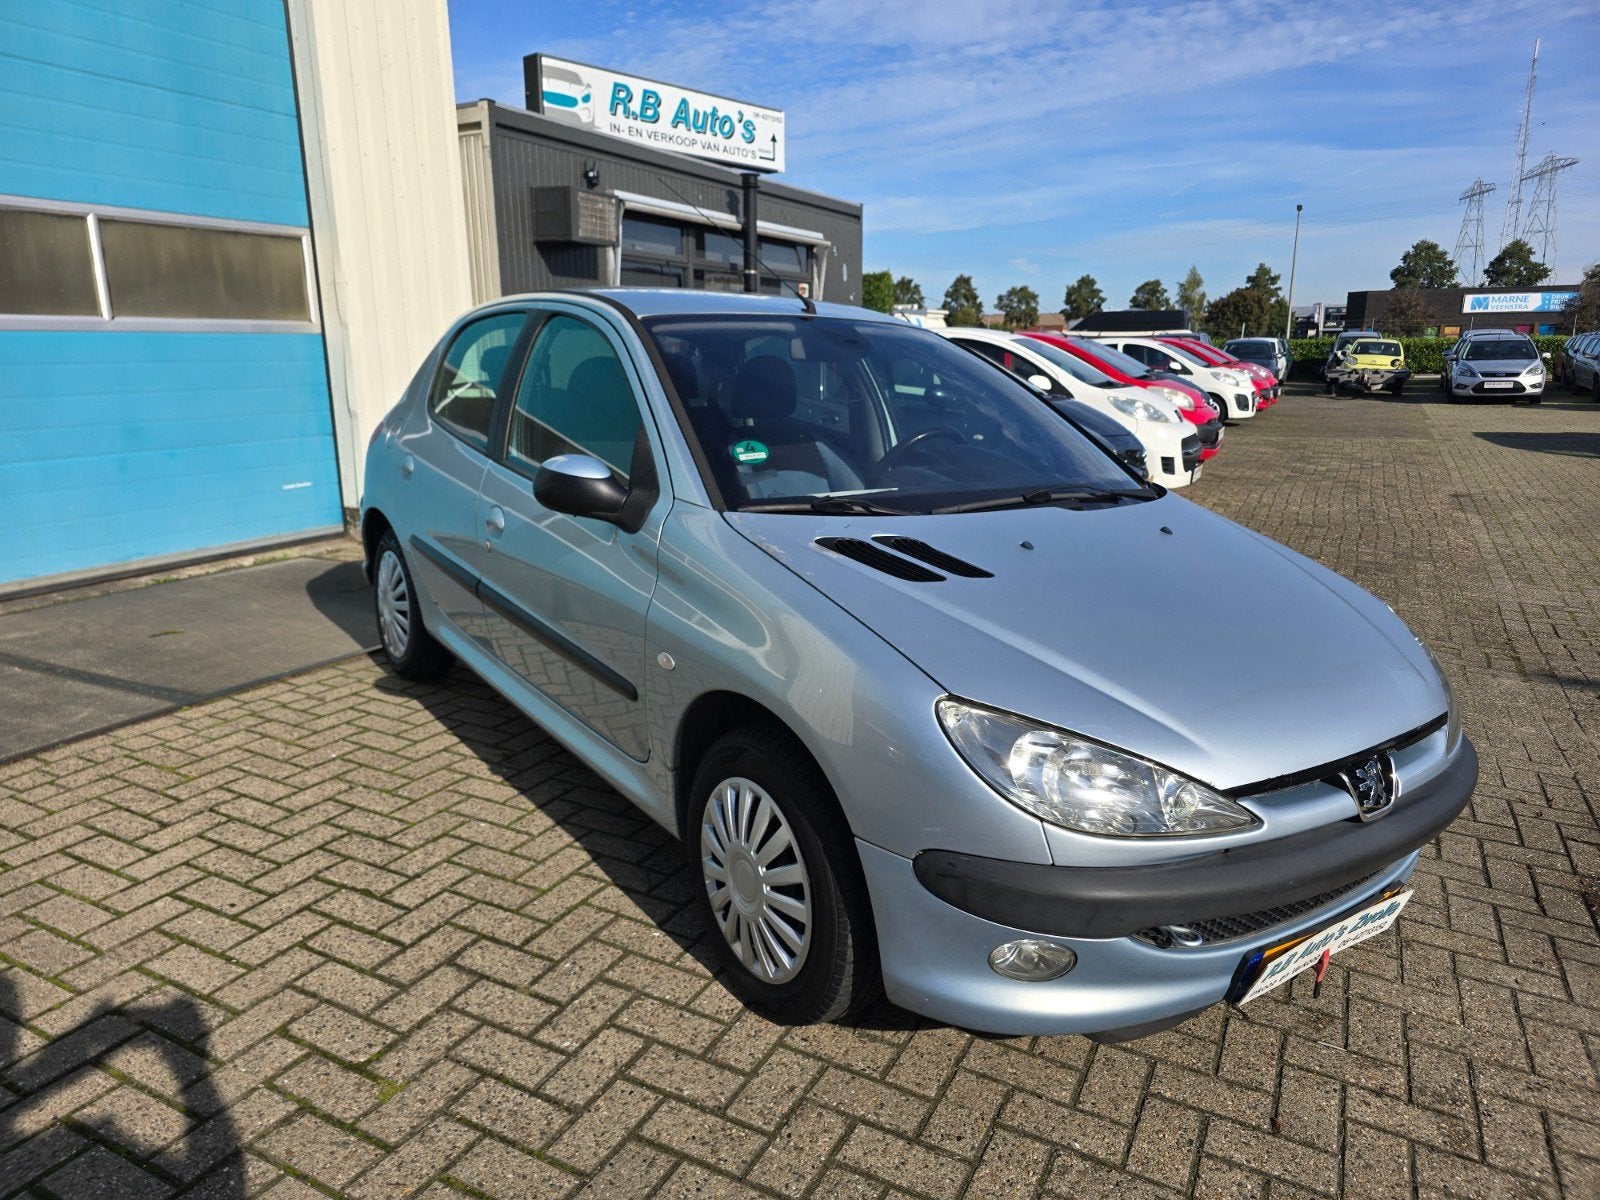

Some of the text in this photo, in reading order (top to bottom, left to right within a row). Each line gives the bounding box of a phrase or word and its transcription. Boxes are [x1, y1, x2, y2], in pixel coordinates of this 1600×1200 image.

[609, 82, 756, 144] R.B Auto's
[609, 123, 625, 134] IN-
[628, 126, 643, 138] EN
[646, 129, 698, 148] VERKOOP
[700, 139, 719, 153] VAN
[723, 145, 757, 160] AUTO'S
[1491, 295, 1530, 304] MARNE
[746, 442, 755, 452] 4
[1294, 925, 1348, 964] Auto's
